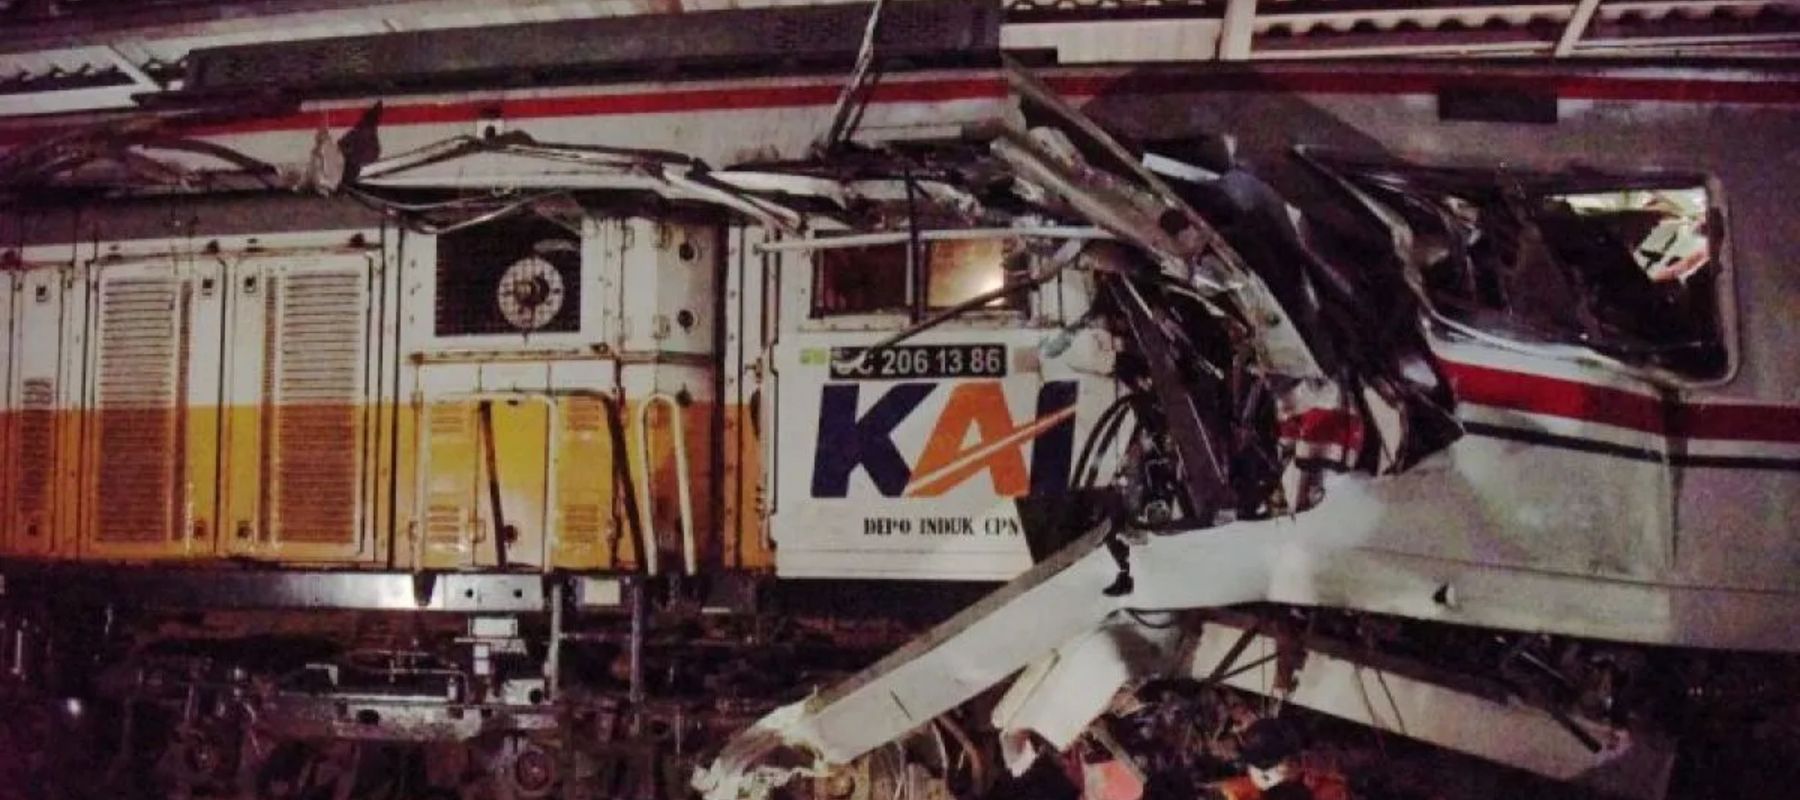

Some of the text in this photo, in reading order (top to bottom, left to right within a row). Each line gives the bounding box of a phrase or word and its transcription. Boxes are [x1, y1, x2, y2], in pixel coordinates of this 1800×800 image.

[881, 349, 928, 375] 206
[936, 348, 963, 374] 13
[971, 348, 1000, 374] 86
[811, 380, 1078, 498] KAI
[863, 517, 1018, 536] DEPO INDUK CPN
